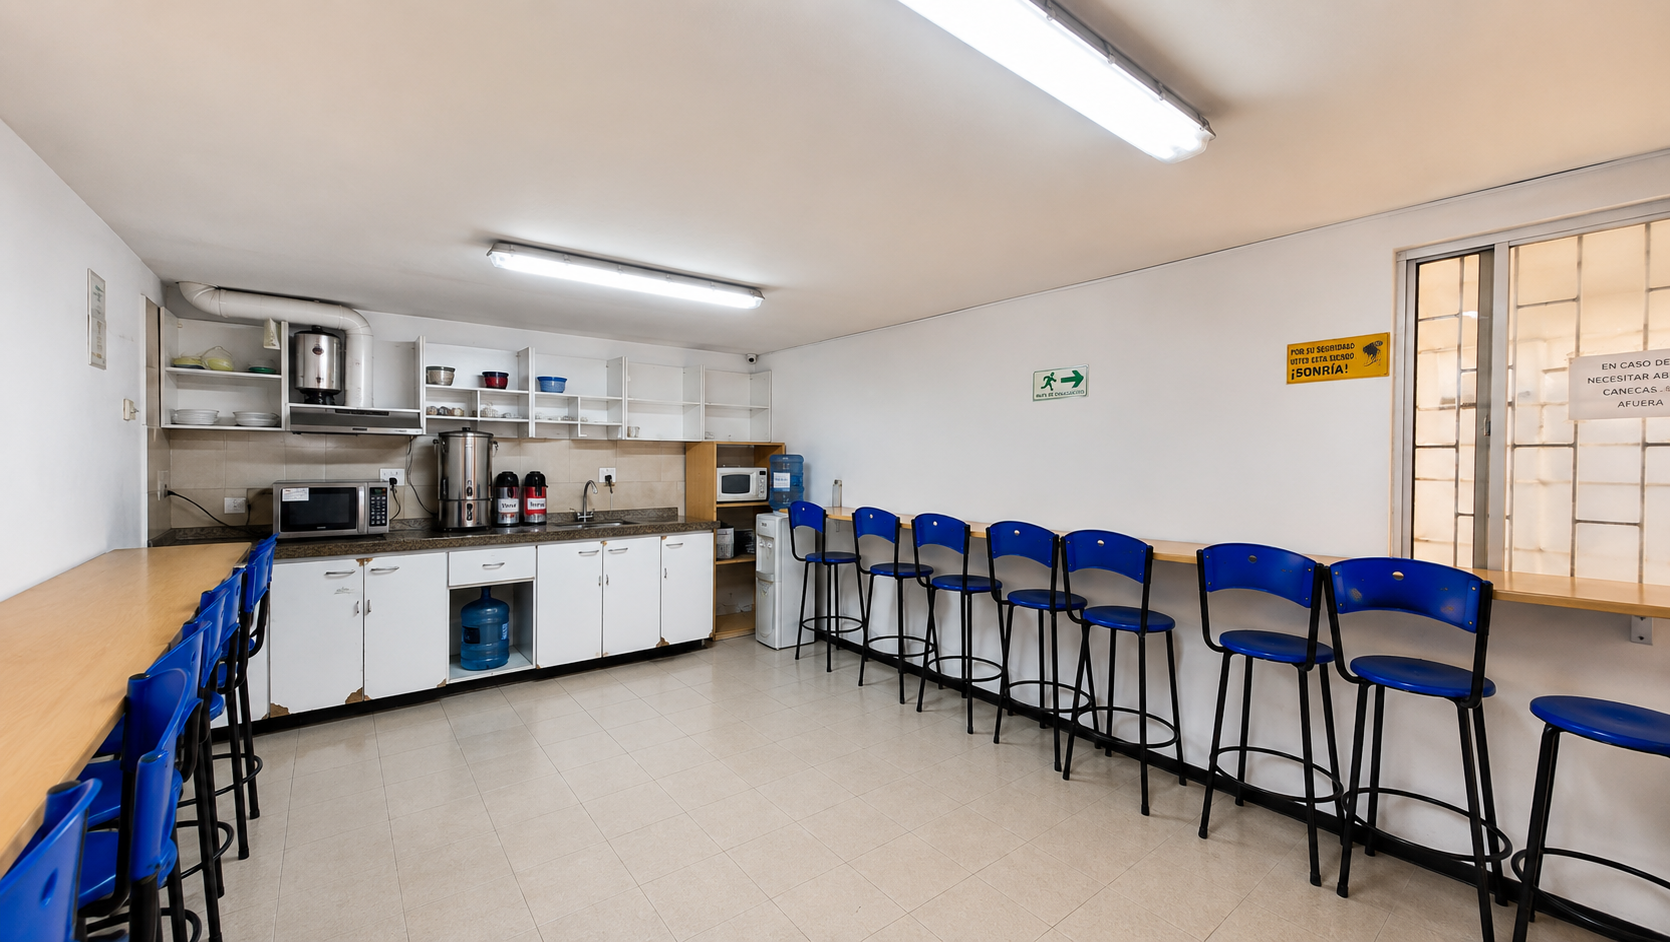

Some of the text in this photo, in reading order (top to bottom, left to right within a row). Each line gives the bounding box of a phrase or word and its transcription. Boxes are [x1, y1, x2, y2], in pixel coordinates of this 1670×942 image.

[1601, 358, 1670, 371] EN CASO DE
[1290, 363, 1349, 381] ¡SONRÍA!
[1587, 373, 1650, 384] NECESITAR
[1617, 399, 1664, 408] AFUERA
